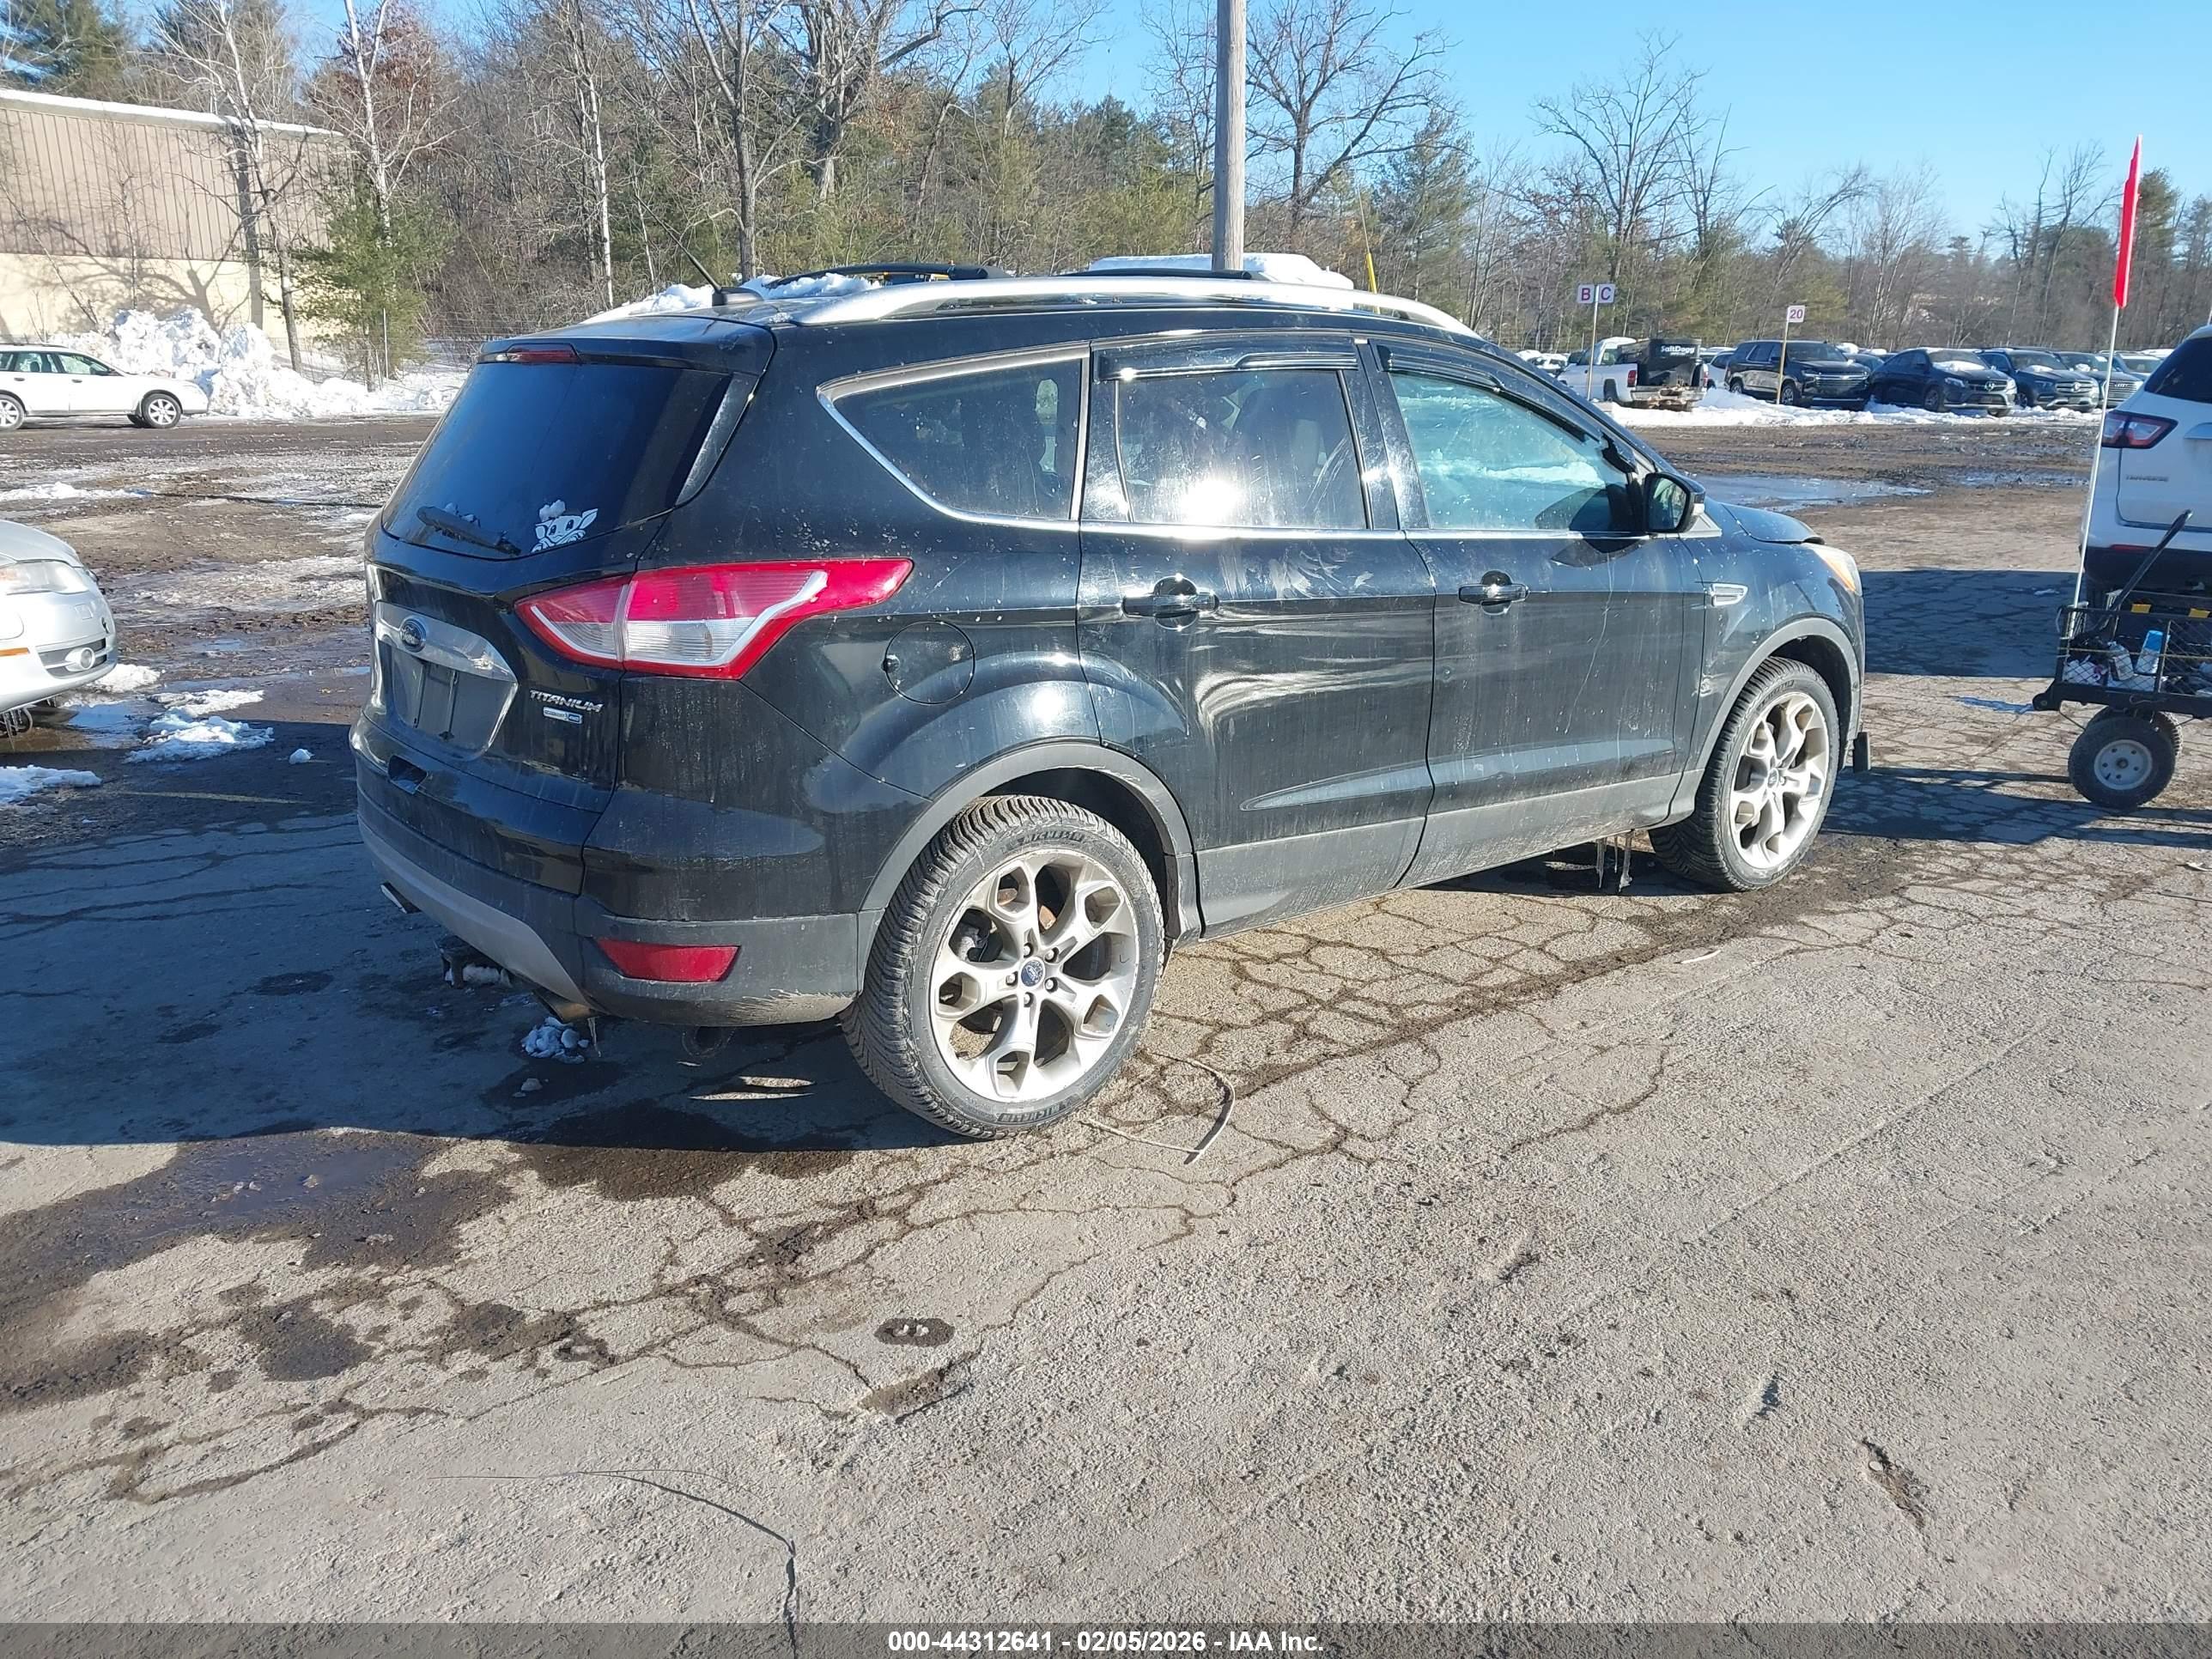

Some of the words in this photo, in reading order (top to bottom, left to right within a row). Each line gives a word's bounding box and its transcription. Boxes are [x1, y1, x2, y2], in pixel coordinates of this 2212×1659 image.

[1581, 287, 1591, 301] B
[1601, 286, 1612, 301] C
[1790, 309, 1803, 319] 20
[1660, 344, 1695, 355] SaltDogg
[529, 690, 605, 713] TITANIUM
